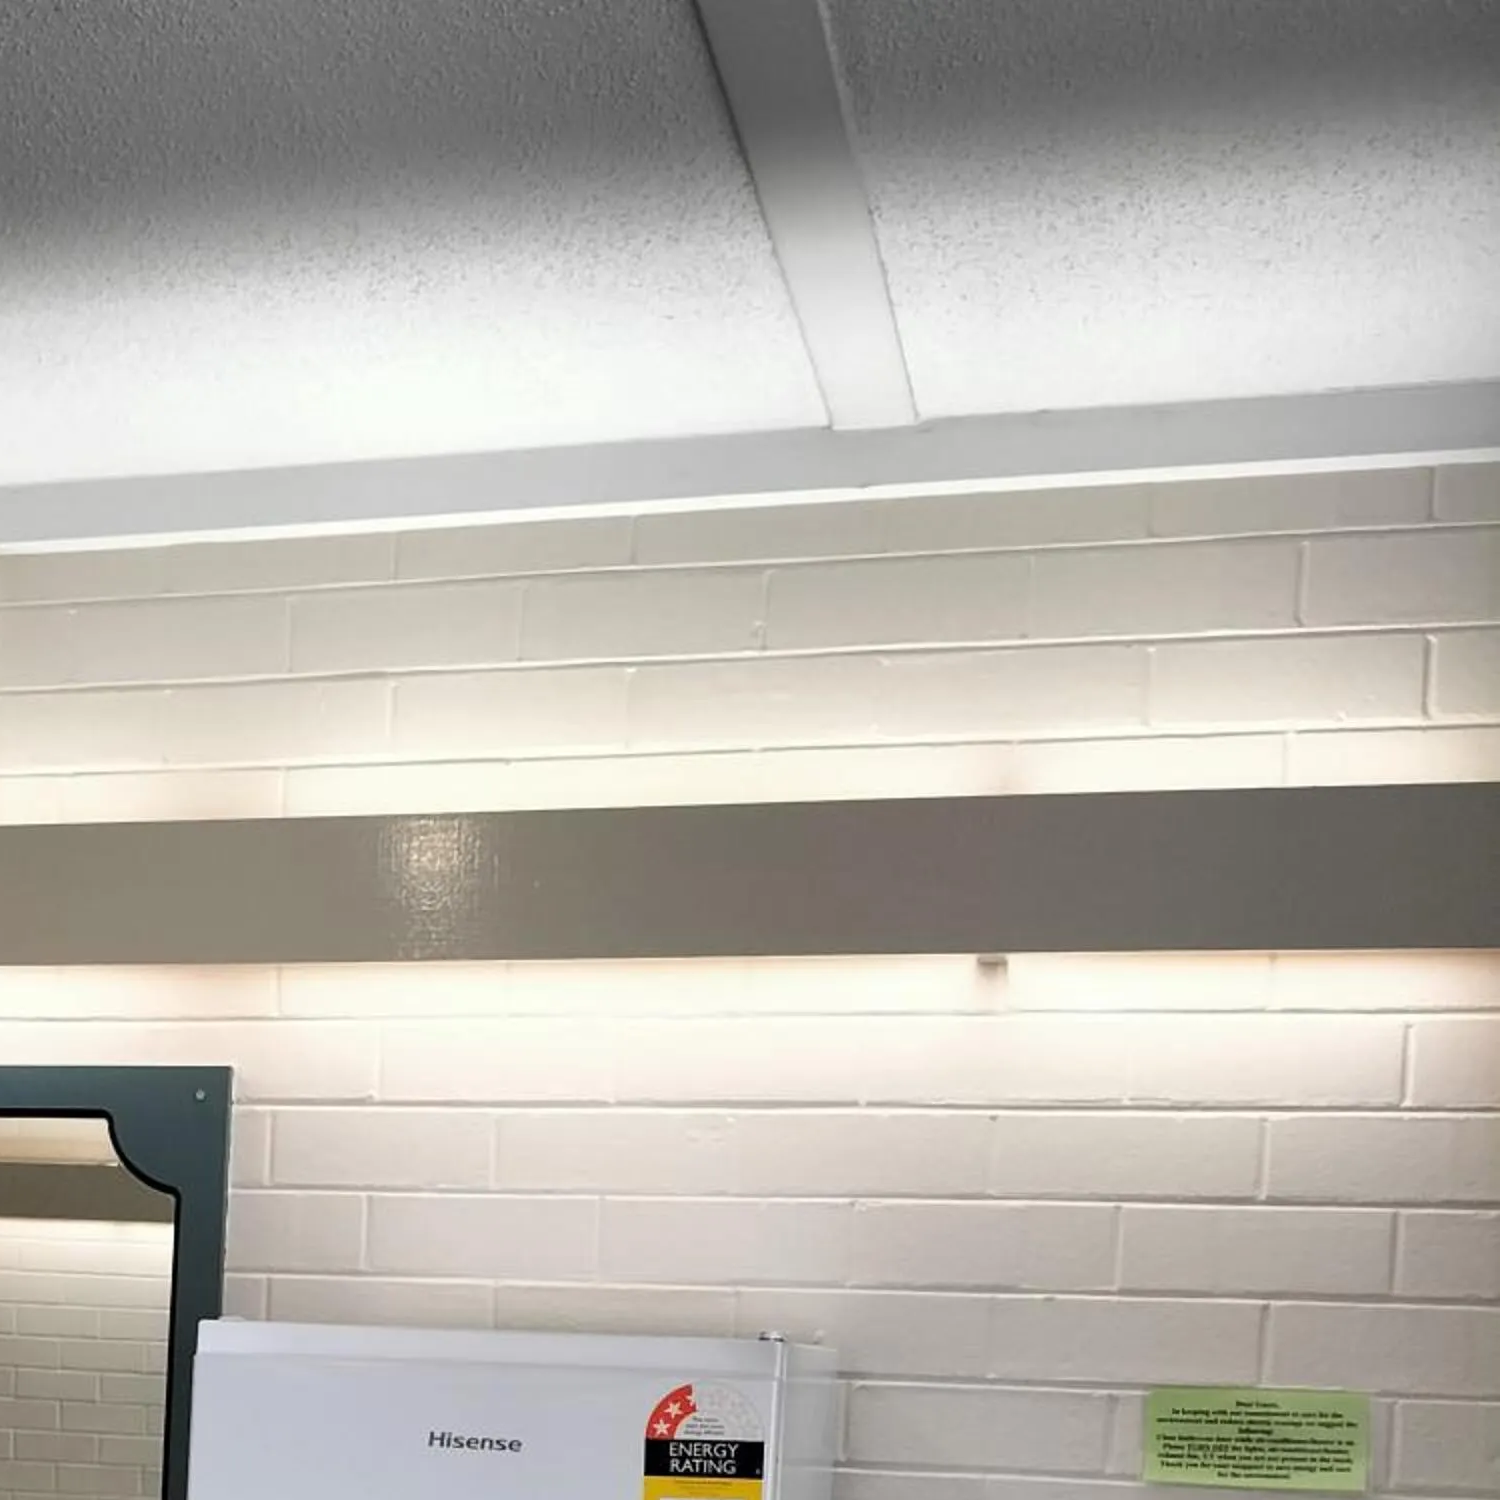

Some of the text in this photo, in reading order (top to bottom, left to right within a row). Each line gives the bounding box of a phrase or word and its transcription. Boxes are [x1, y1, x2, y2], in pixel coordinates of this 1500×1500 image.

[428, 1430, 523, 1453] Hisense
[669, 1443, 739, 1458] ENERGY
[669, 1459, 737, 1475] RATING
